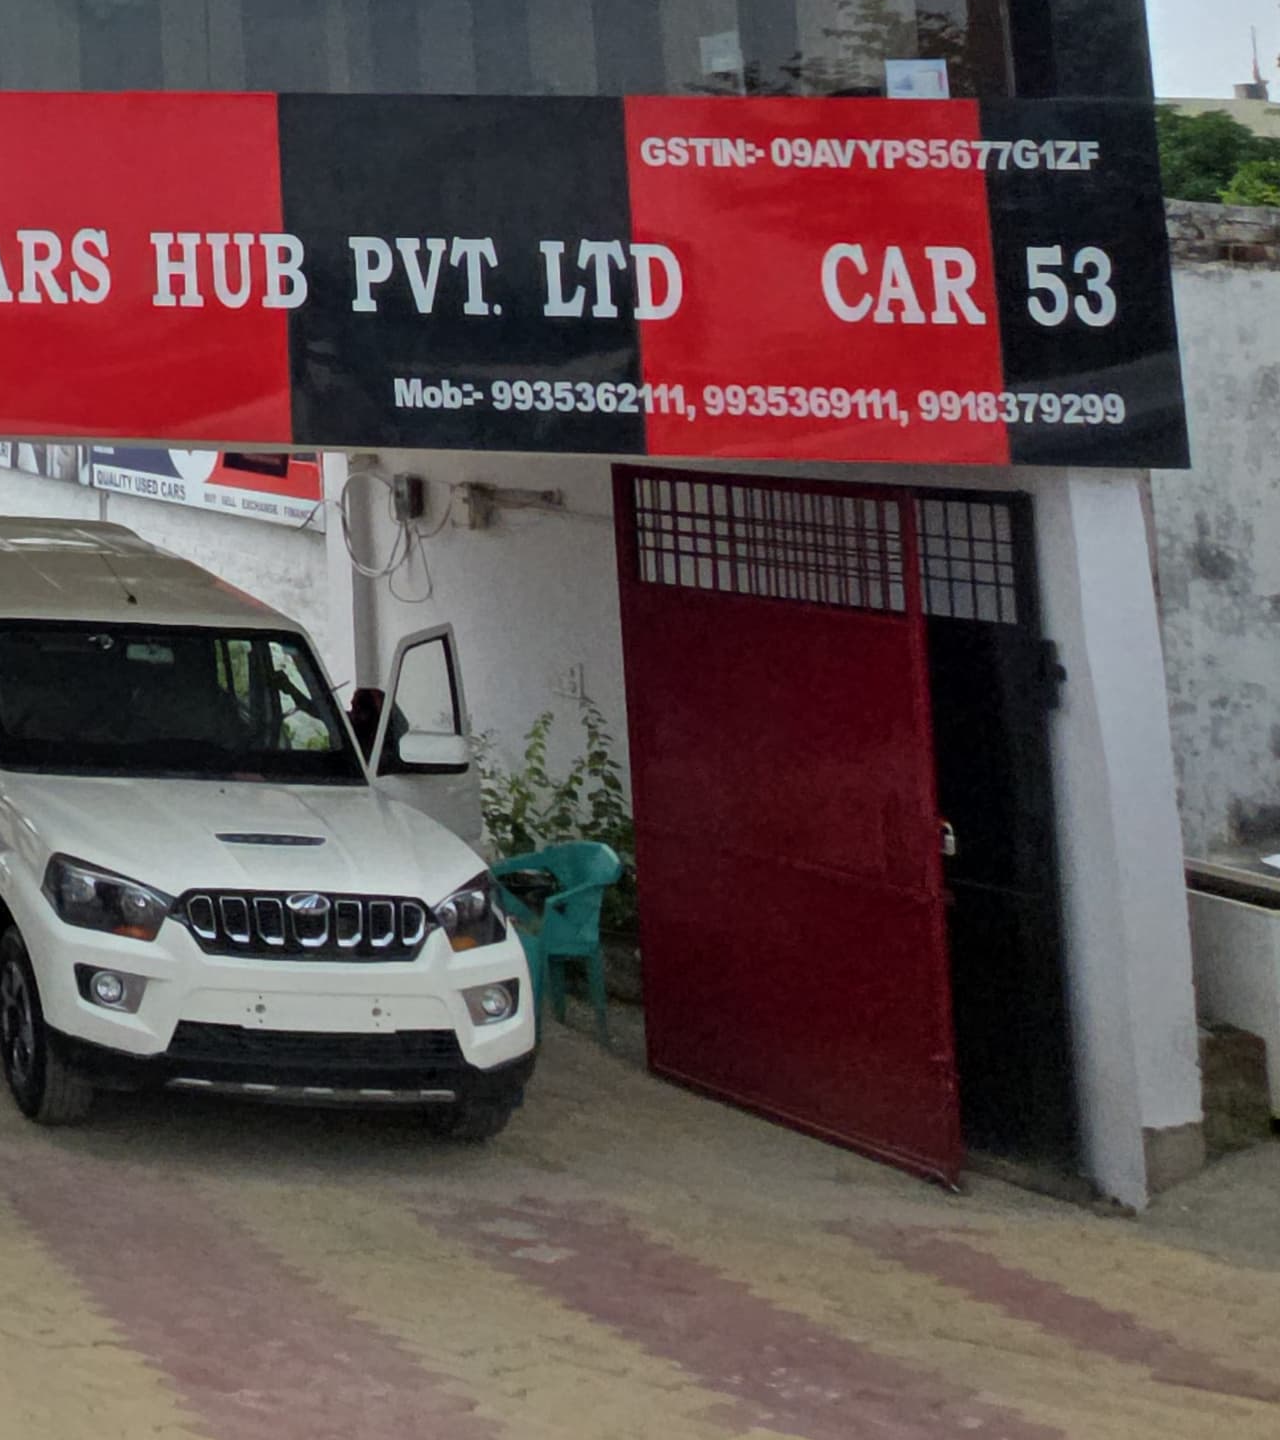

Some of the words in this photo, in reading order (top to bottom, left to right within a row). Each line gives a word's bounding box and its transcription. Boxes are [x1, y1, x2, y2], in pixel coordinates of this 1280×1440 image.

[149, 232, 308, 309] HUB
[348, 236, 503, 317] PVT.
[540, 240, 684, 320] LTD
[820, 243, 986, 325] CAR
[1026, 245, 1117, 328] 53
[491, 381, 696, 422] 9935362111,
[703, 385, 909, 426] 9935369111,
[918, 390, 1126, 424] 9918379299
[96, 469, 132, 489] QUALITY
[135, 476, 159, 495] USED
[160, 481, 187, 501] CARS
